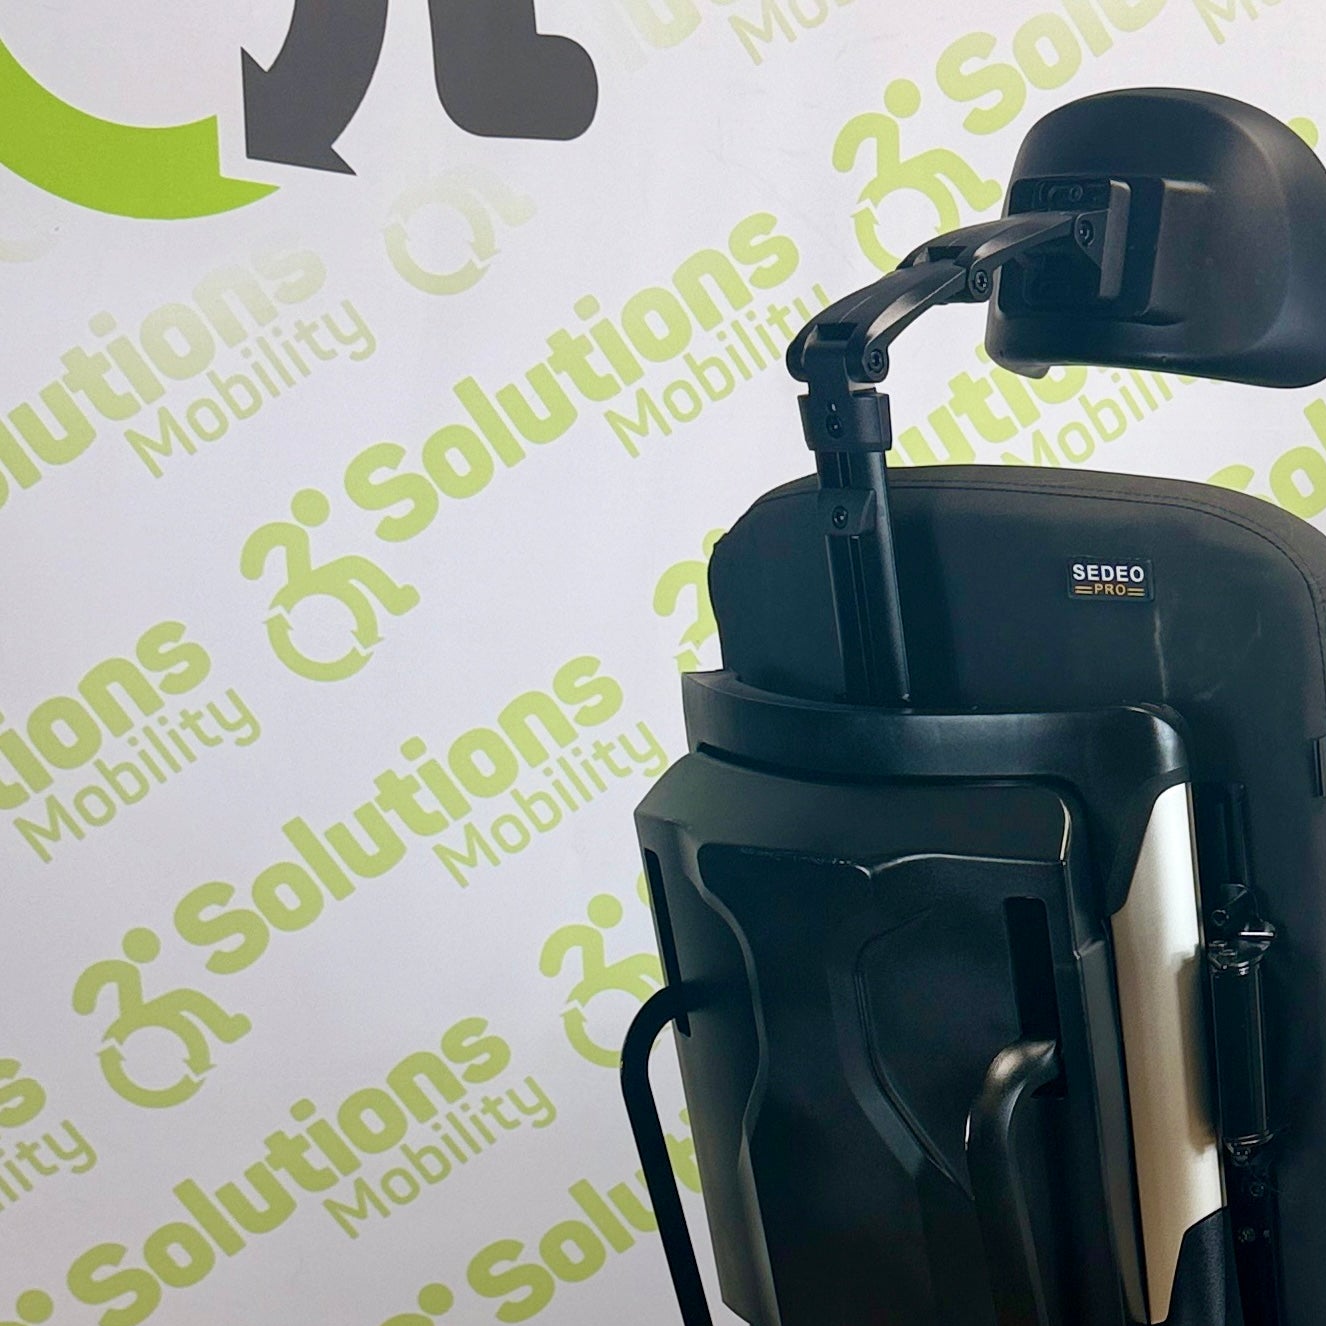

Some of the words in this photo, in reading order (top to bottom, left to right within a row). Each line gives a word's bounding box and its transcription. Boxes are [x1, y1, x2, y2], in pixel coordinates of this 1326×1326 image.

[0, 243, 328, 508] olutions
[124, 299, 377, 479] Mobility
[344, 212, 800, 542] Solutions
[1072, 563, 1145, 583] SEDEO
[1094, 583, 1126, 596] PRO
[12, 687, 262, 864] Mobility
[174, 656, 624, 975] Solutions
[433, 718, 668, 887] Mobility
[323, 1075, 557, 1238] Mobility
